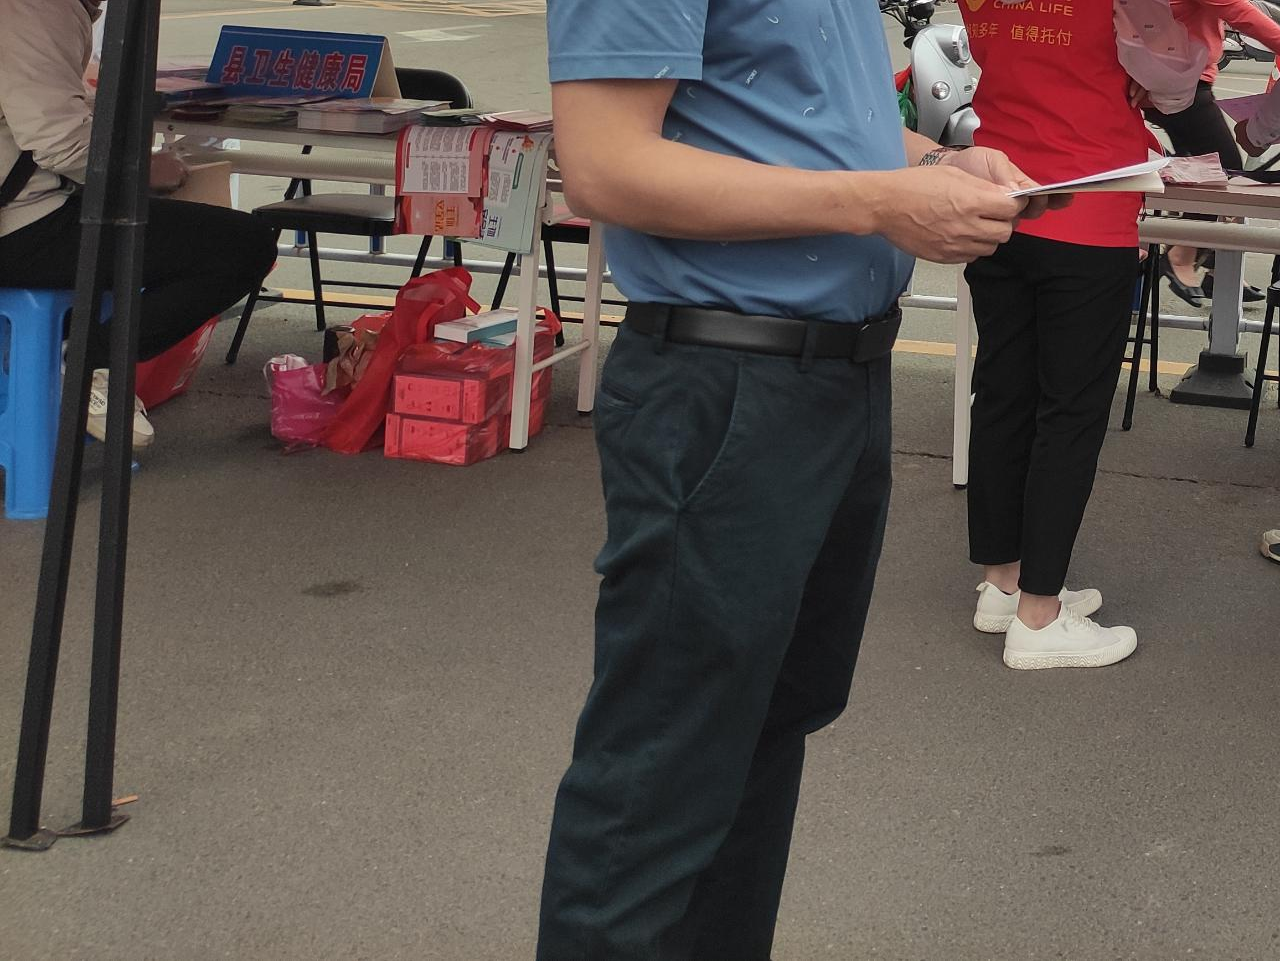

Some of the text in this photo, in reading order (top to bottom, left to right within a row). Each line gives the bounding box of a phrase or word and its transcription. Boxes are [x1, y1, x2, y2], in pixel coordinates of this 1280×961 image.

[1039, 2, 1074, 17] LIFE
[1011, 23, 1072, 46] 值得托付
[221, 45, 369, 93] 县卫生健康局
